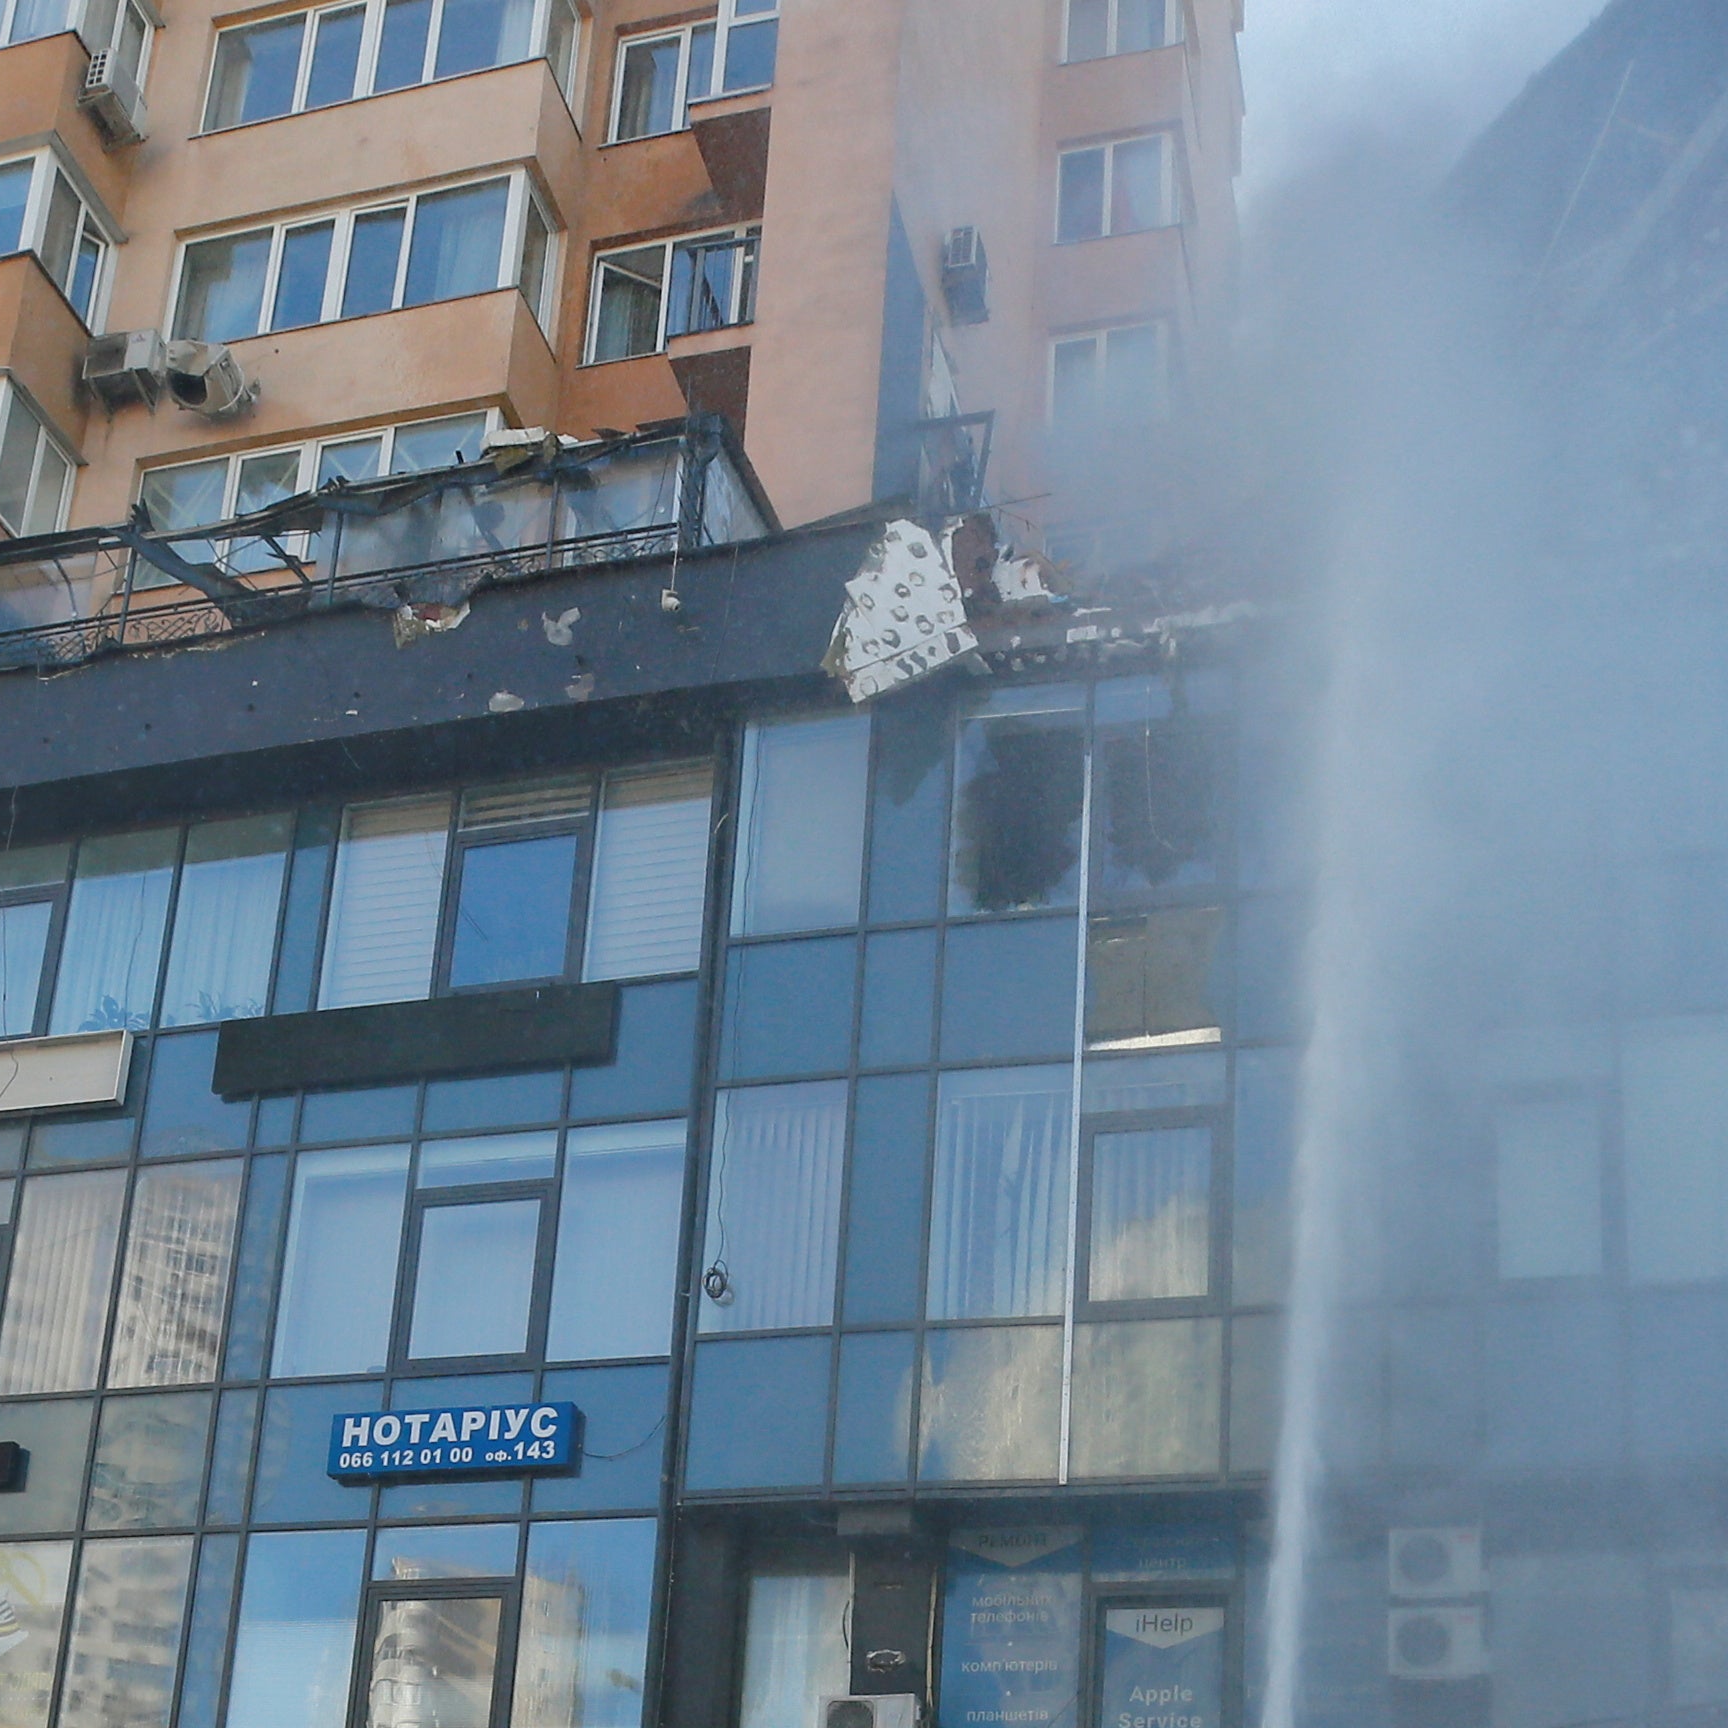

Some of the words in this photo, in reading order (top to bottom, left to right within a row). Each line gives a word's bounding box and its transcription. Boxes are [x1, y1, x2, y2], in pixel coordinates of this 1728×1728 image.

[341, 1406, 558, 1448] НОТАРІУС
[339, 1452, 373, 1469] 066
[380, 1450, 413, 1467] 112
[420, 1448, 442, 1465] 01
[449, 1447, 473, 1464] 00
[970, 1609, 1049, 1625] телефонів
[1135, 1613, 1193, 1636] iHelp
[961, 1659, 1059, 1675] комп'ютерів
[1129, 1684, 1194, 1706] Apple
[966, 1708, 1049, 1724] планшетів
